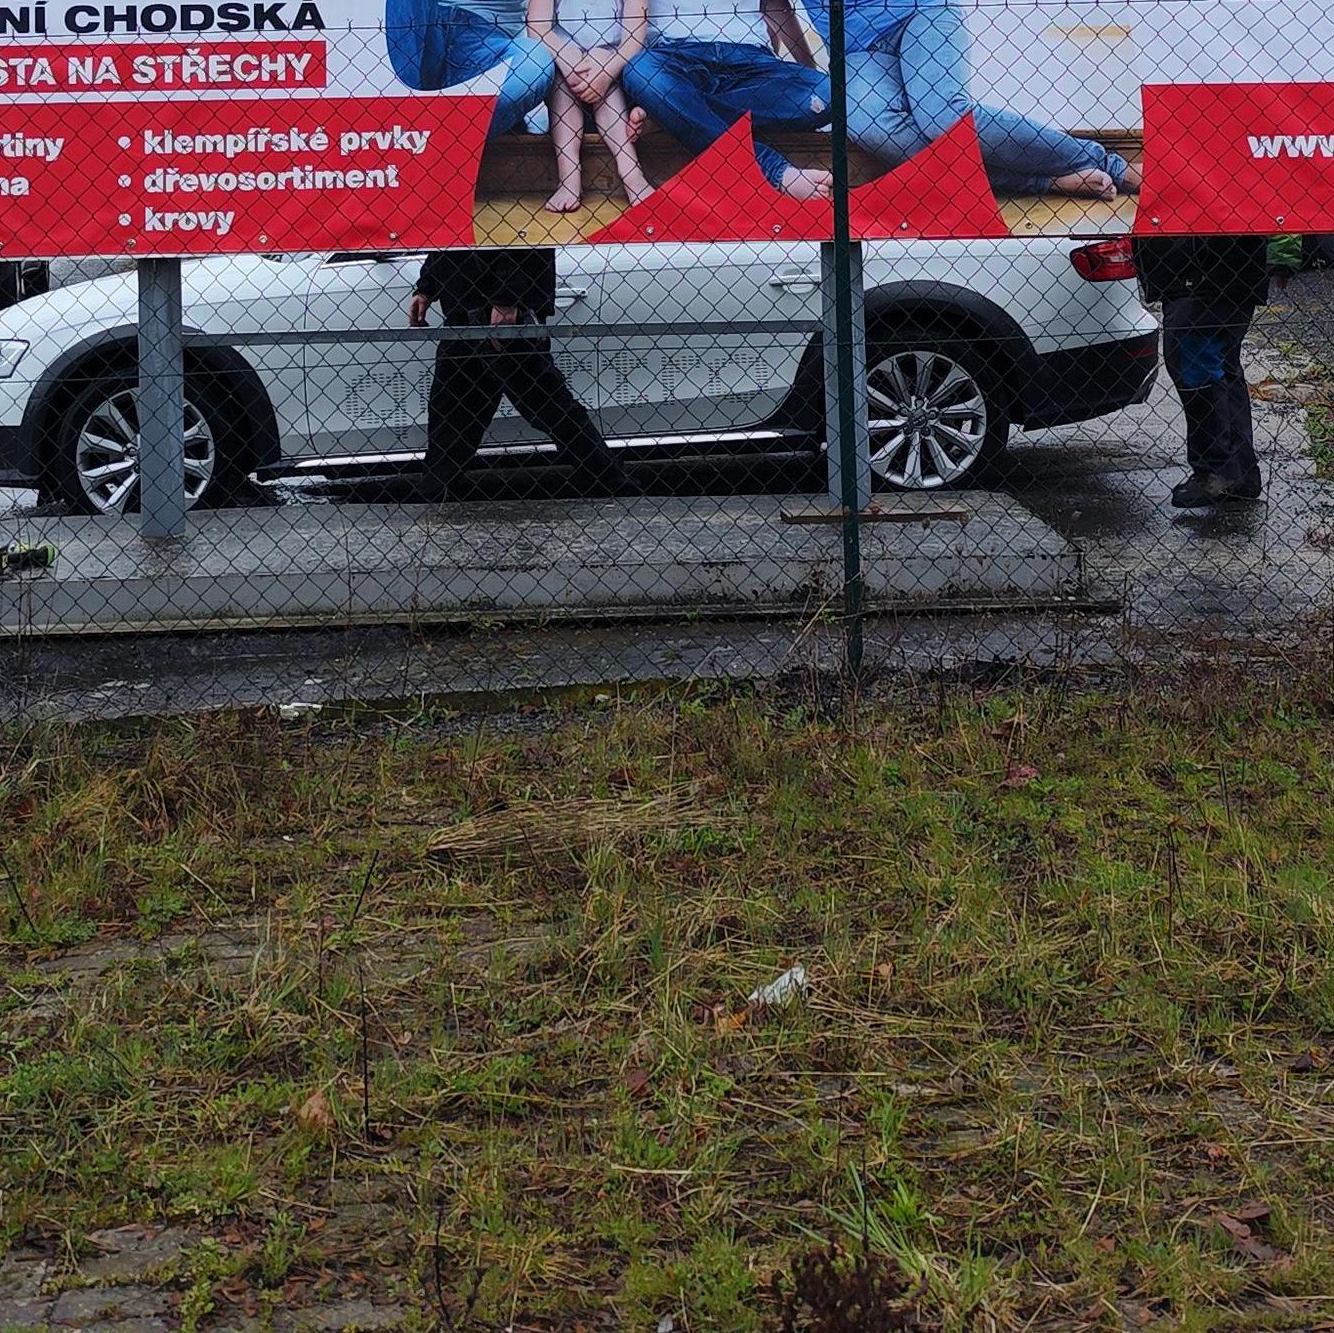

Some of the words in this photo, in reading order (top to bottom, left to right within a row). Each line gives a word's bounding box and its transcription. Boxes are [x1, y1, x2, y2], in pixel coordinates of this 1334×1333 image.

[68, 56, 122, 86] NA
[131, 48, 313, 84] STŘECHY
[143, 126, 329, 158] klempířské
[339, 125, 432, 156] prvky
[143, 165, 400, 193] dřevosortiment
[143, 206, 235, 236] krovy
